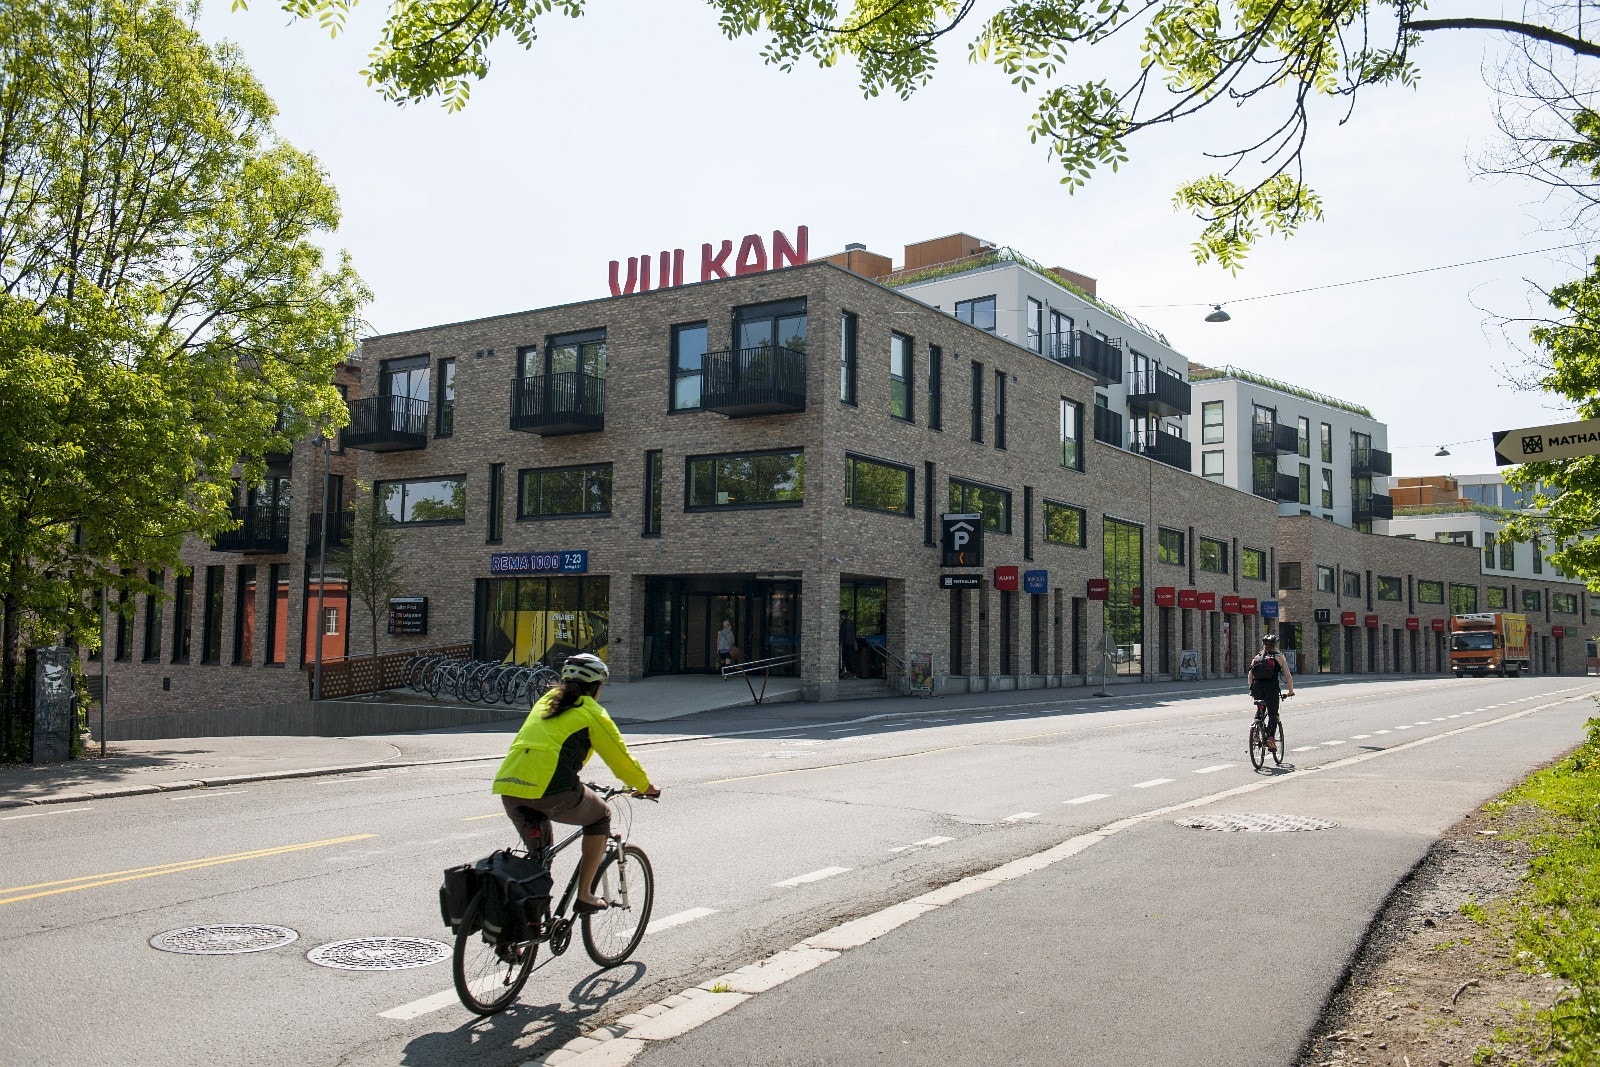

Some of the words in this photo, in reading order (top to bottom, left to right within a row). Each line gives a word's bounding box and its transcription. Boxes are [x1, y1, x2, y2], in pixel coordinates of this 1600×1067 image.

[954, 531, 970, 551] P
[492, 556, 528, 571] REMA
[531, 555, 559, 570] 1000
[565, 553, 582, 564] 7-23
